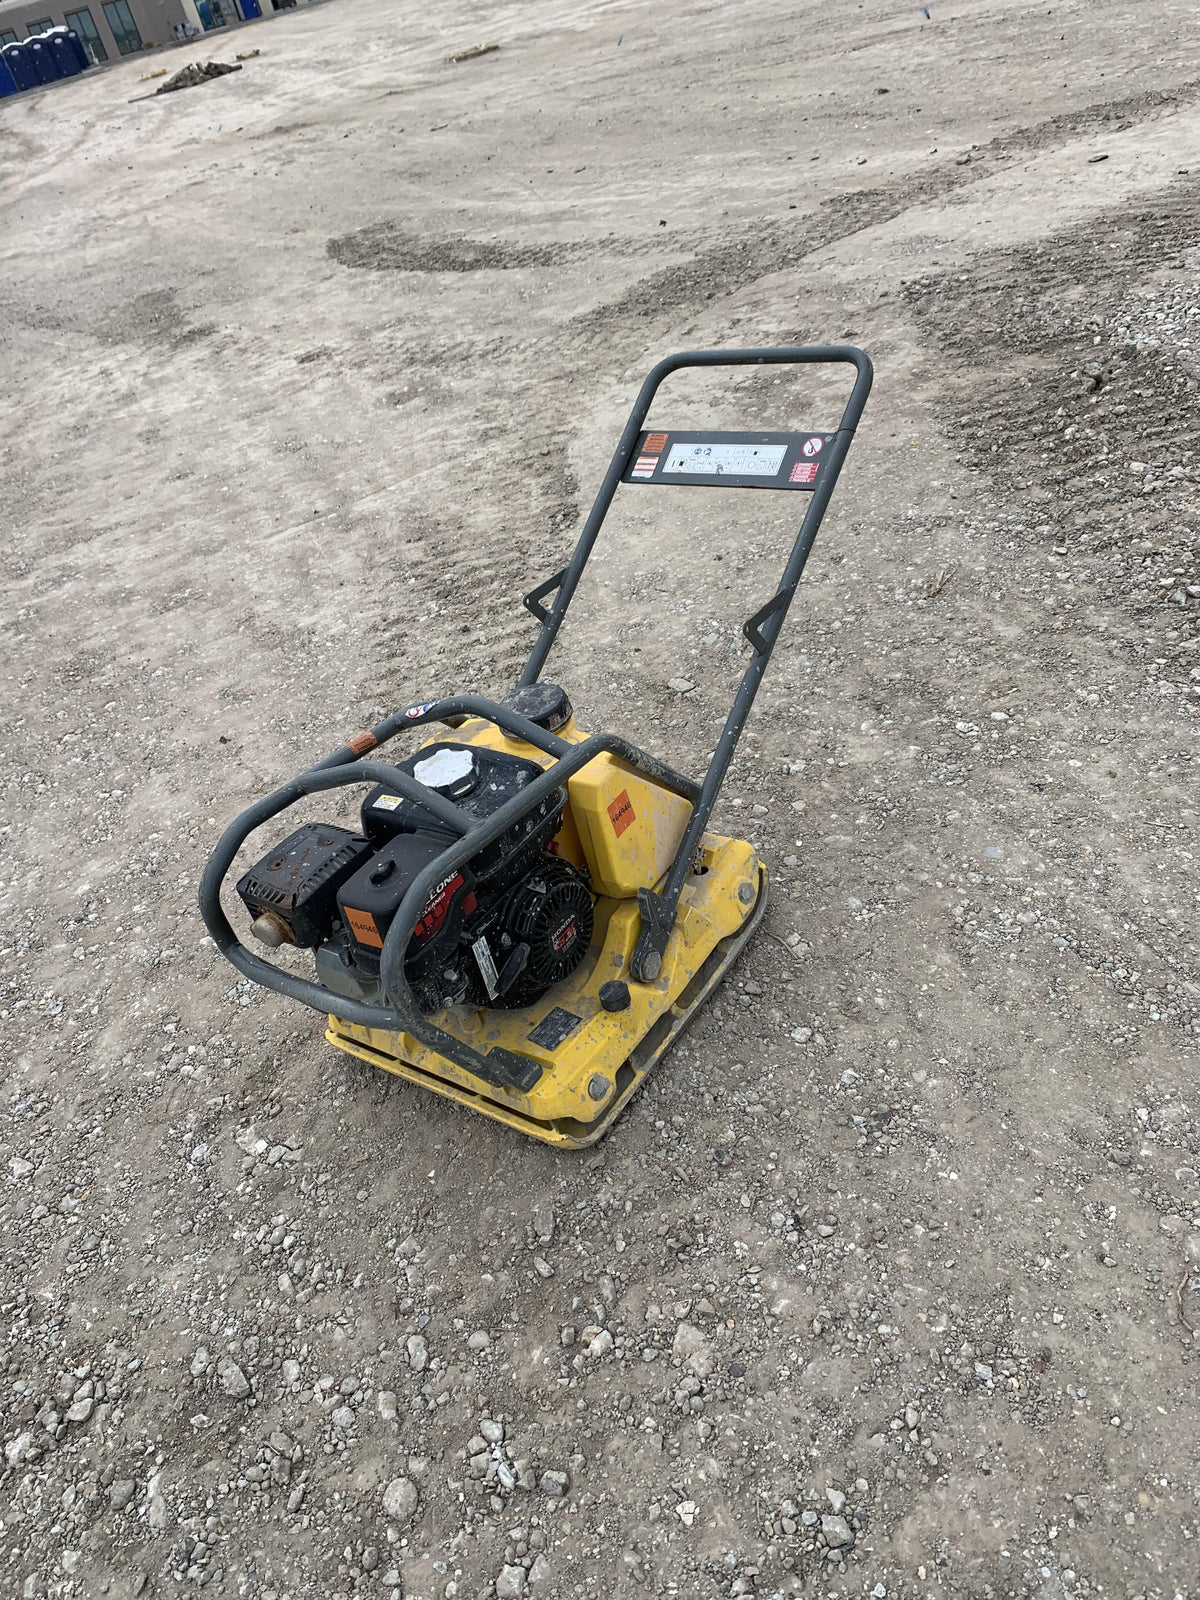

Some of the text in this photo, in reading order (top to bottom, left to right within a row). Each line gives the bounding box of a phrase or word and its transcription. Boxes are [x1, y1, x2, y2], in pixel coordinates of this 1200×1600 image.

[426, 870, 459, 905] LONE
[351, 921, 378, 934] 164946
[551, 914, 575, 939] HONDA
